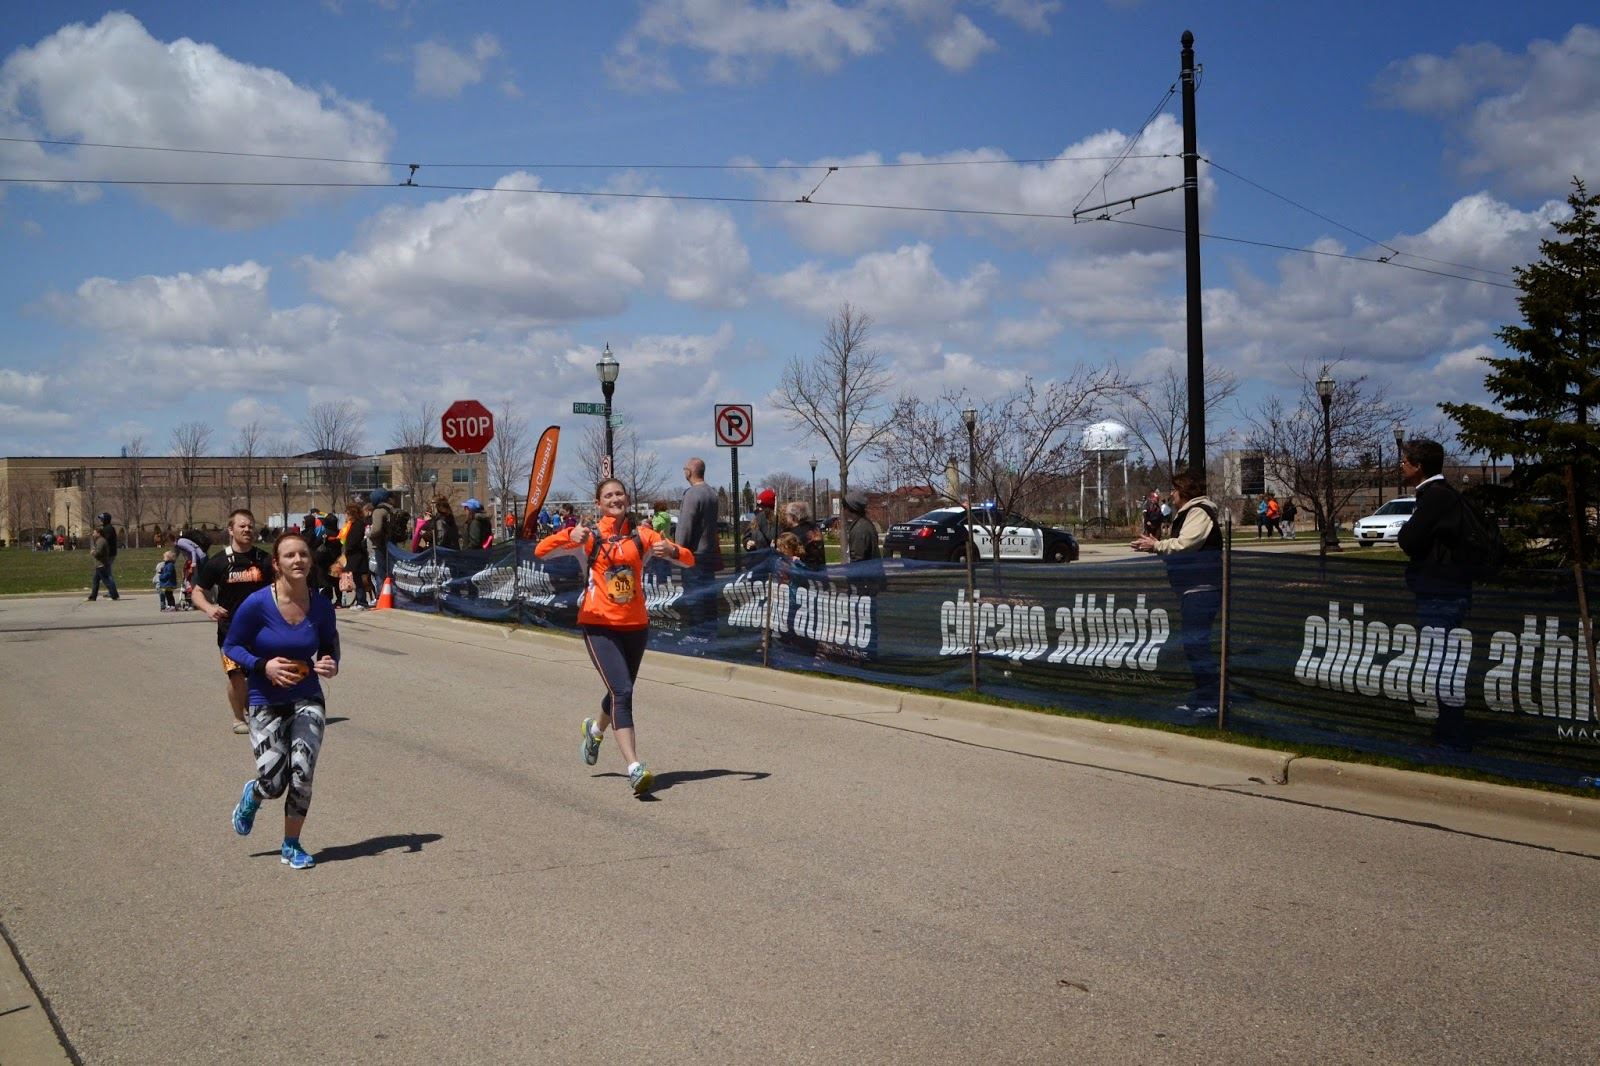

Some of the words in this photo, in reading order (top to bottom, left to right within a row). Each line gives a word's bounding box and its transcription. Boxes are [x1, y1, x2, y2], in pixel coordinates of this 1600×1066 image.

[445, 416, 490, 438] STOP
[574, 404, 591, 413] RING
[595, 405, 605, 413] RD
[530, 487, 542, 505] Say
[794, 579, 871, 649] athlete
[939, 588, 1048, 666] chicago
[1047, 593, 1170, 671] athlete
[1294, 600, 1473, 719] chicago
